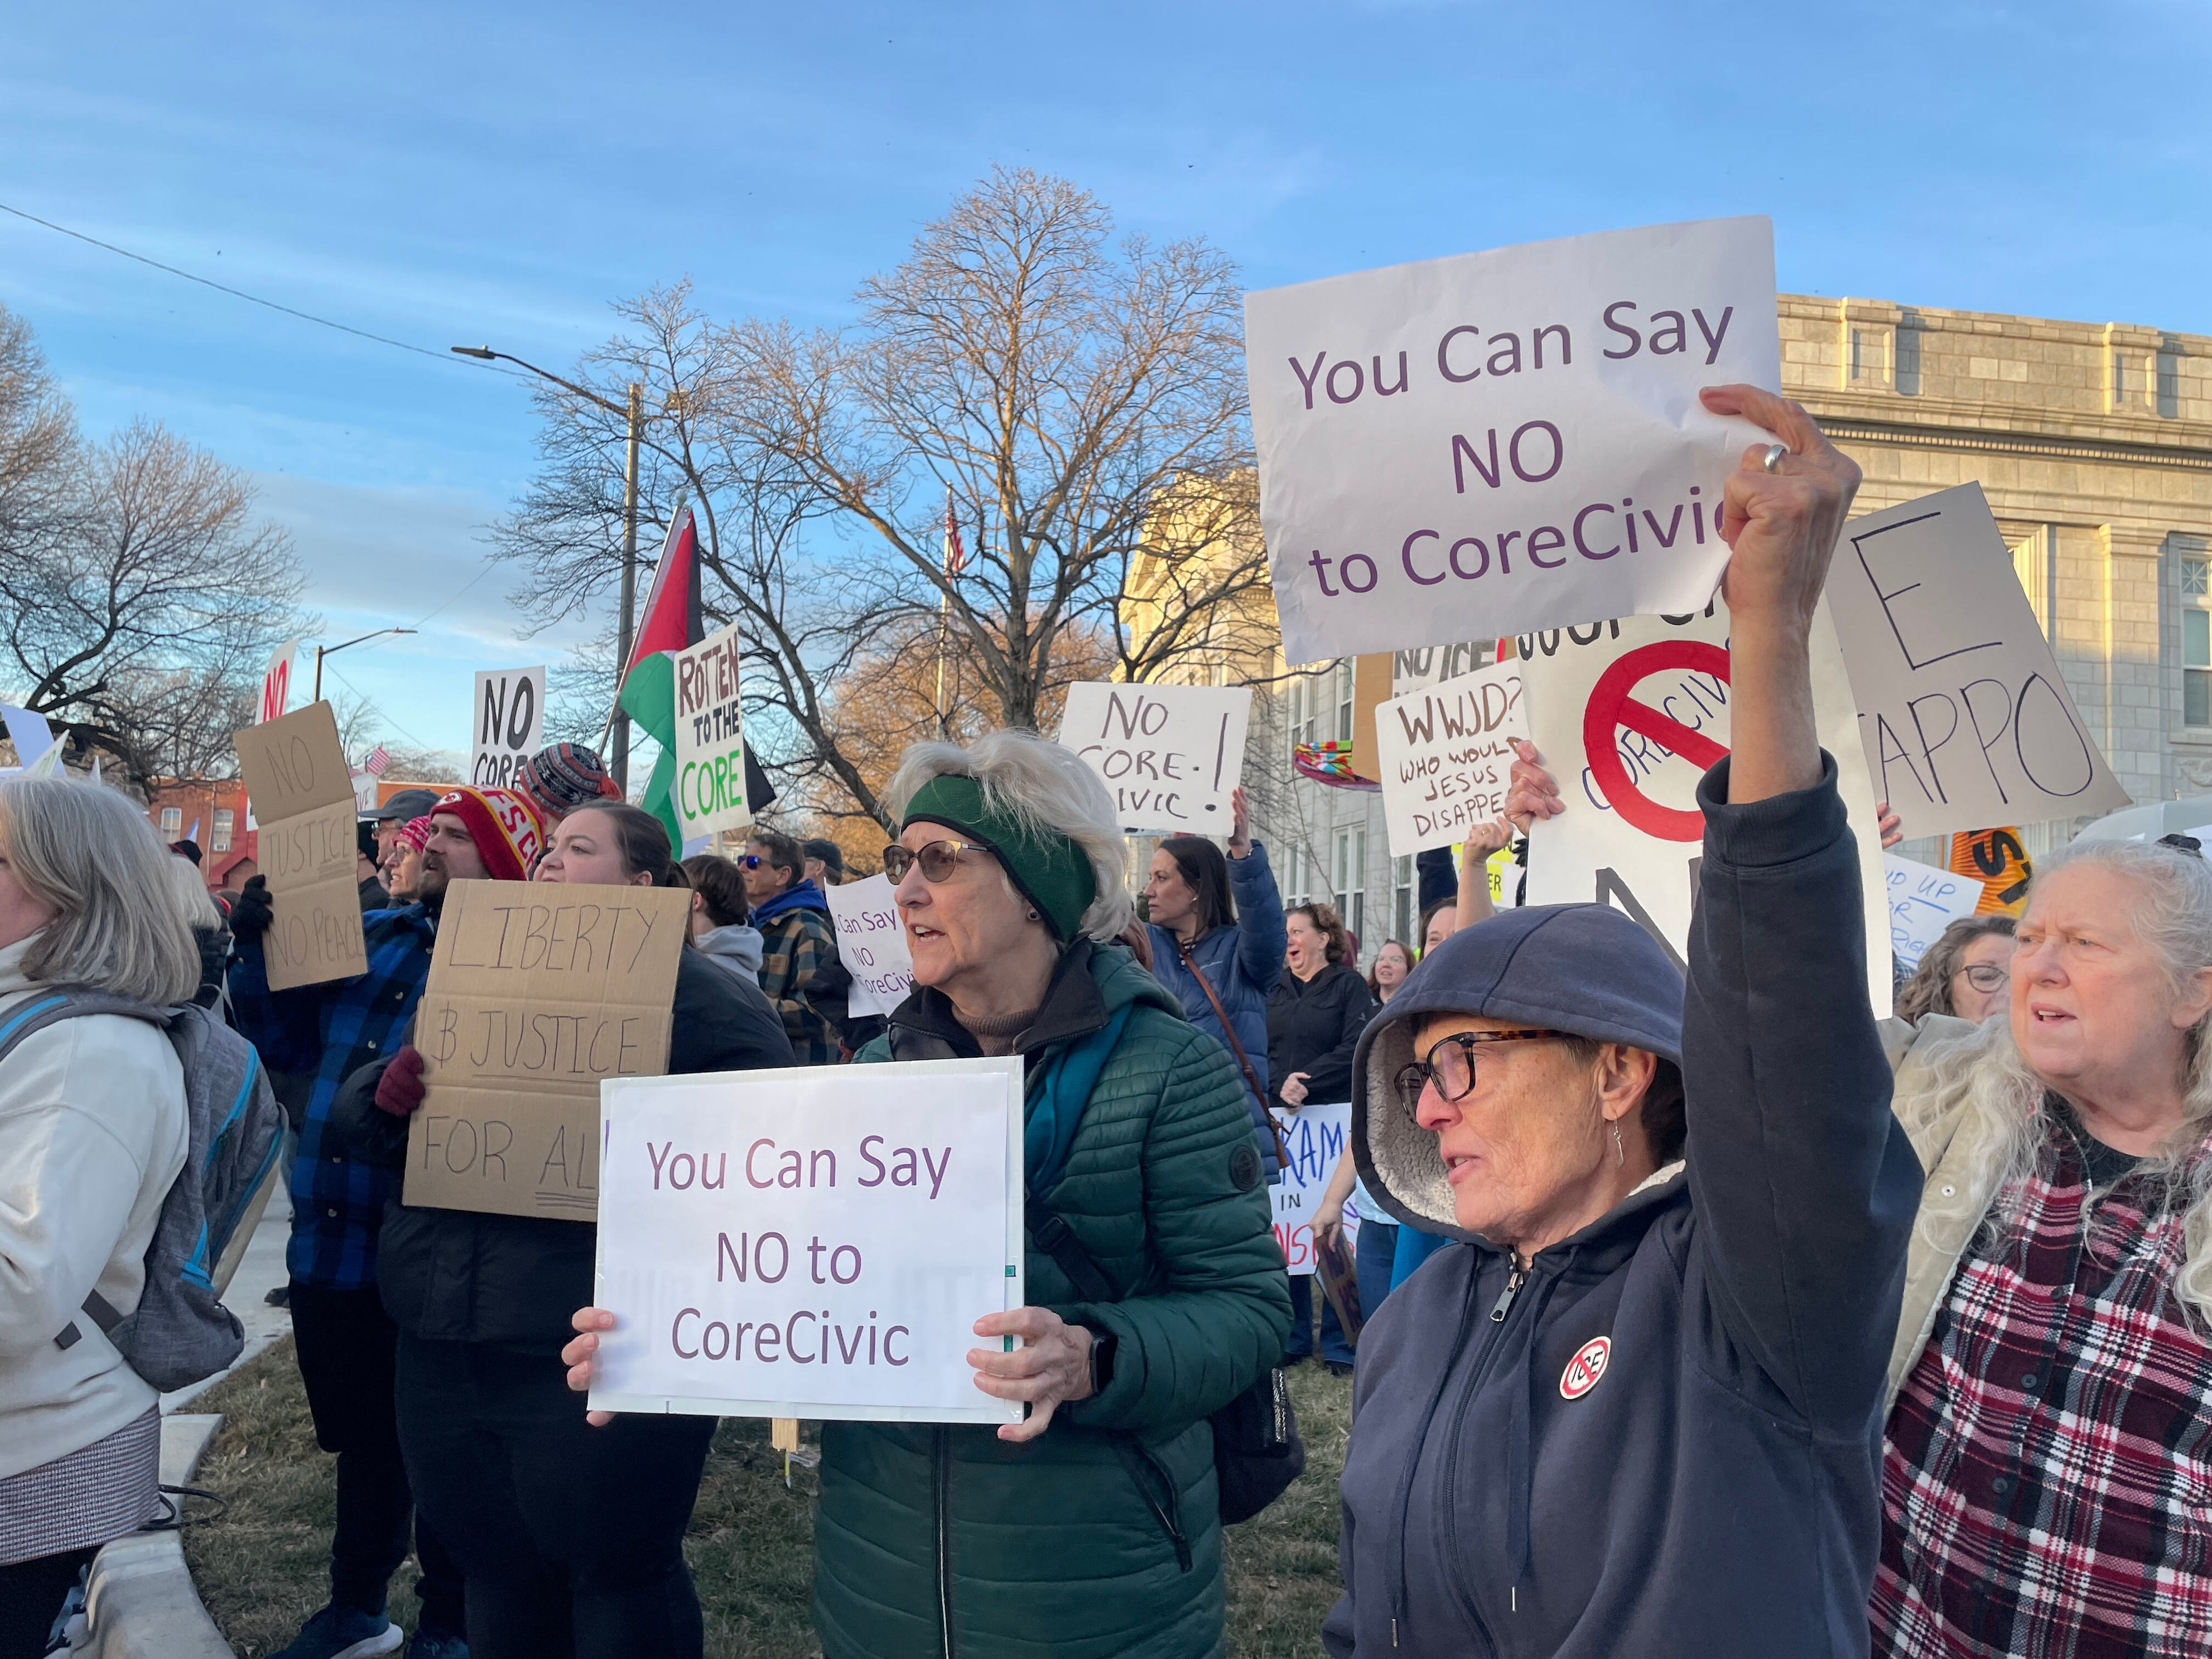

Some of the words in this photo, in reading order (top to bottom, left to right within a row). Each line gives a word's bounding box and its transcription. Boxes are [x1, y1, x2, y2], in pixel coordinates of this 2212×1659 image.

[1289, 350, 1409, 409] You
[1438, 324, 1572, 383] Can
[1602, 301, 1733, 366] Say
[1451, 420, 1563, 494] NO
[1309, 549, 1378, 596] to
[263, 659, 287, 724] NO
[679, 631, 739, 717] ROTTEN
[481, 676, 534, 750] NO
[693, 713, 711, 747] TO
[712, 699, 740, 742] THE
[1101, 691, 1169, 740] NO
[1397, 677, 1522, 746] WWJD?
[1858, 671, 2093, 806] APPO
[265, 735, 314, 798] NO
[681, 749, 743, 821] CORE
[1400, 756, 1440, 784] WHO
[1425, 765, 1498, 802] JESUS
[1118, 788, 1188, 819] IVIC
[1413, 792, 1504, 837] DISAPPE
[266, 813, 351, 880] JUSTICE
[1917, 875, 1956, 899] UP
[268, 914, 307, 971] NO
[312, 907, 365, 963] PEACE
[449, 905, 658, 973] LIBERTY
[838, 914, 862, 933] Can
[862, 909, 897, 931] Say
[851, 947, 874, 967] NO
[470, 1010, 640, 1074] JUSTICE
[424, 1116, 513, 1182] FOR
[539, 1124, 596, 1189] AL
[647, 1140, 726, 1190] You
[745, 1138, 837, 1189] Can
[857, 1135, 952, 1199] Say
[1280, 1193, 1301, 1211] IN
[717, 1231, 789, 1284] NO
[807, 1236, 862, 1284] to
[671, 1308, 910, 1366] CoreCivic
[1571, 1351, 1603, 1383] ICE
